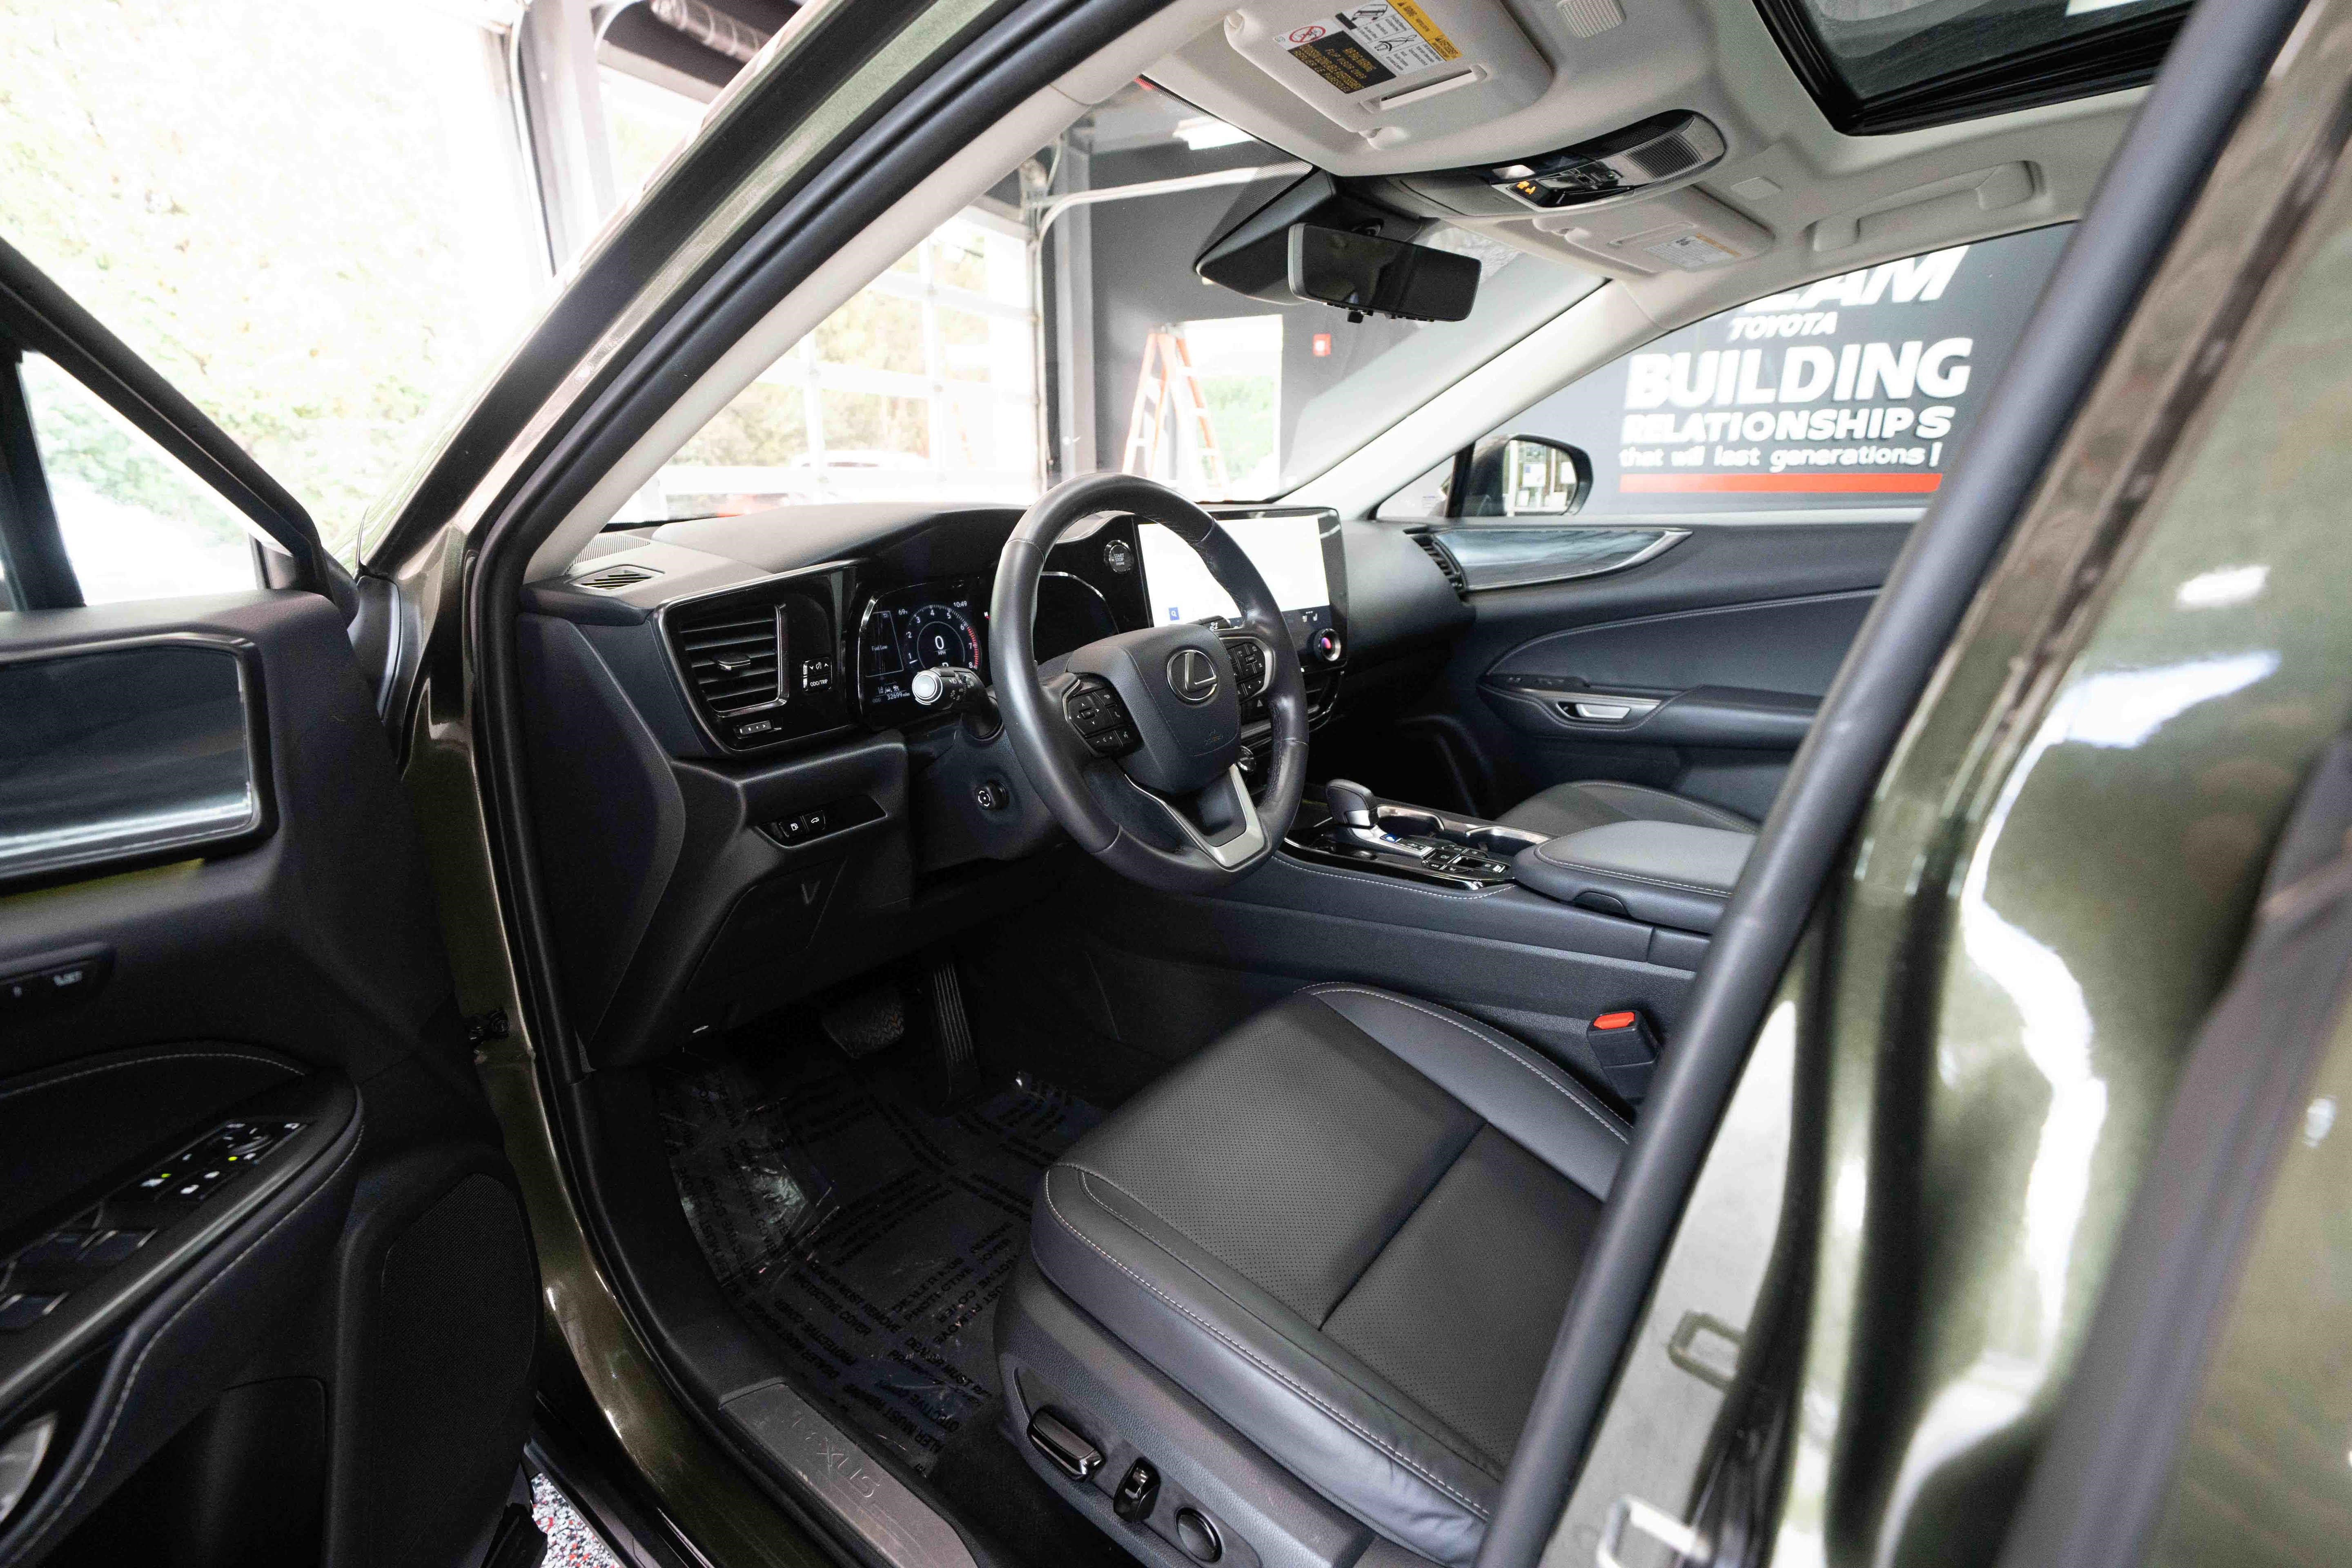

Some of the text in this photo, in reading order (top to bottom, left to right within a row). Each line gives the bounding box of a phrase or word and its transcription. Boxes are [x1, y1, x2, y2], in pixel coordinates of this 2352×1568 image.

[1744, 245, 1970, 312] AM
[1728, 312, 1838, 342] TOYOTA
[1624, 337, 1973, 408] BUILDING
[1623, 406, 1956, 444] RELATIONSHIPS
[1619, 446, 1664, 467] that
[1671, 445, 1705, 466] will
[1714, 445, 1761, 466] last
[935, 635, 944, 650] 0
[886, 692, 902, 700] 32699
[839, 1284, 863, 1306] MUST
[863, 1301, 899, 1334] REMOVE
[840, 1310, 870, 1337] COVER
[943, 1364, 971, 1388] MUST
[884, 1406, 916, 1434] MUST
